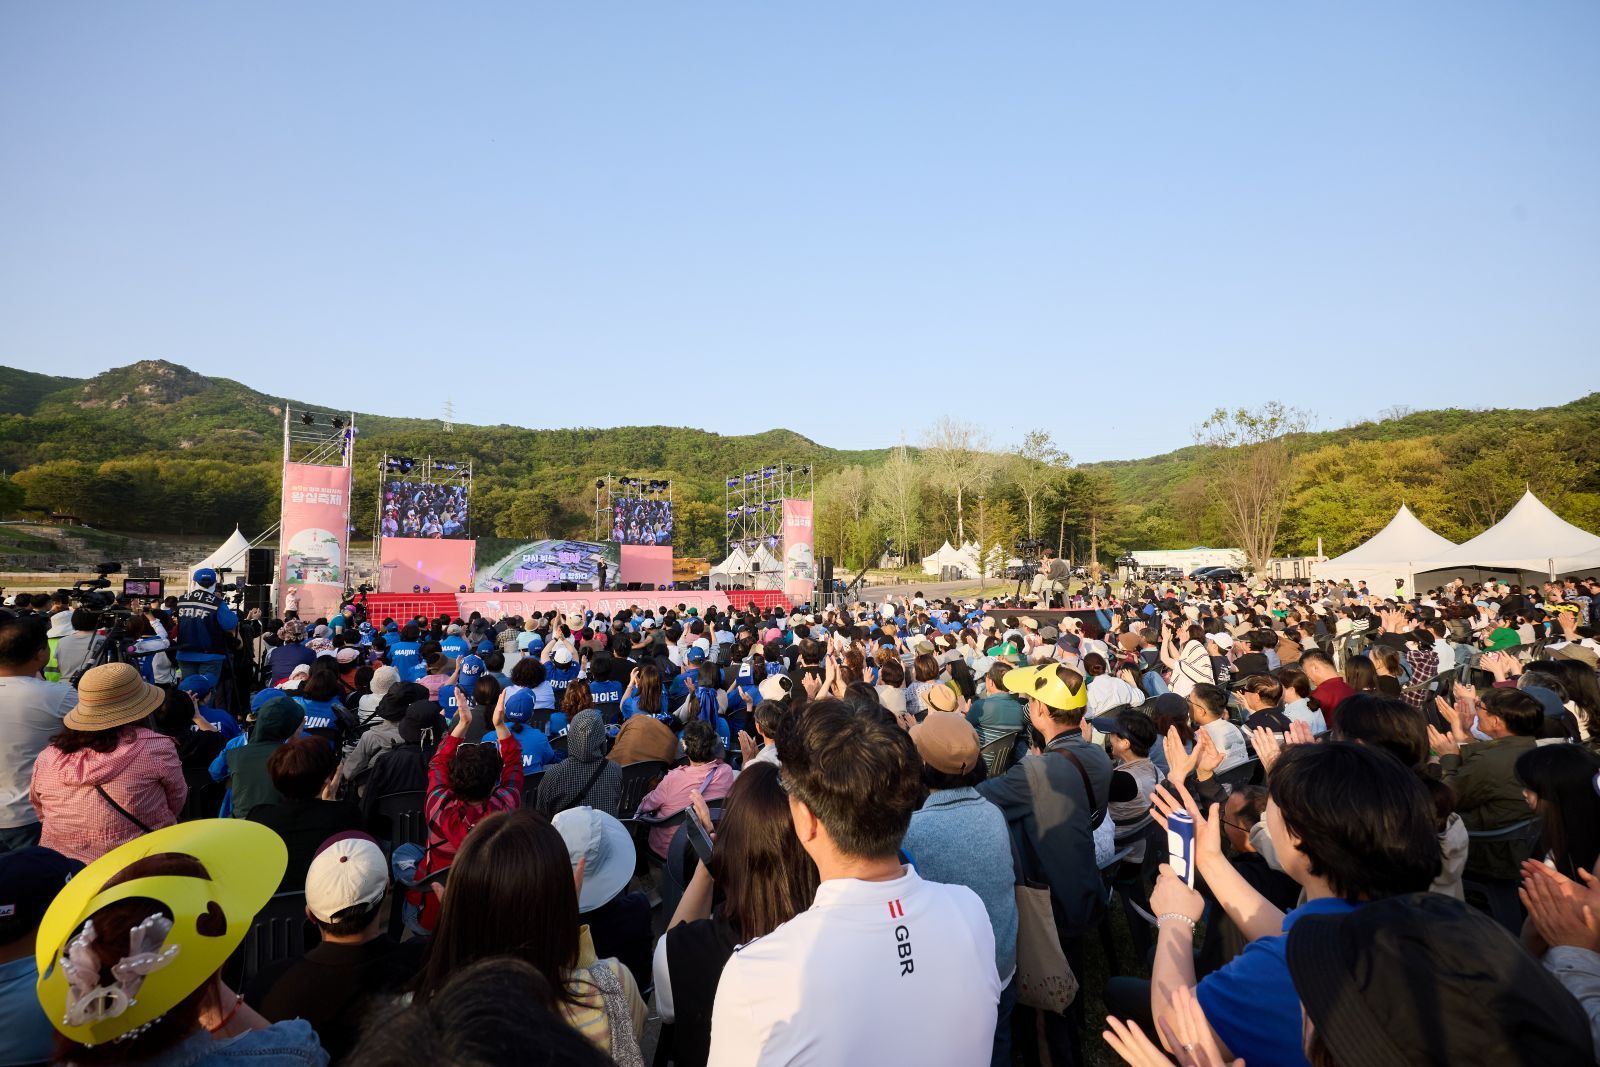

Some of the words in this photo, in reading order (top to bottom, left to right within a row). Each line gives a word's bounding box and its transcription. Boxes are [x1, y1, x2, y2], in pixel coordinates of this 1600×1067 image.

[522, 554, 538, 563] 다시
[178, 608, 211, 619] STAFF
[303, 715, 331, 729] AIJIN
[895, 925, 914, 977] GBR
